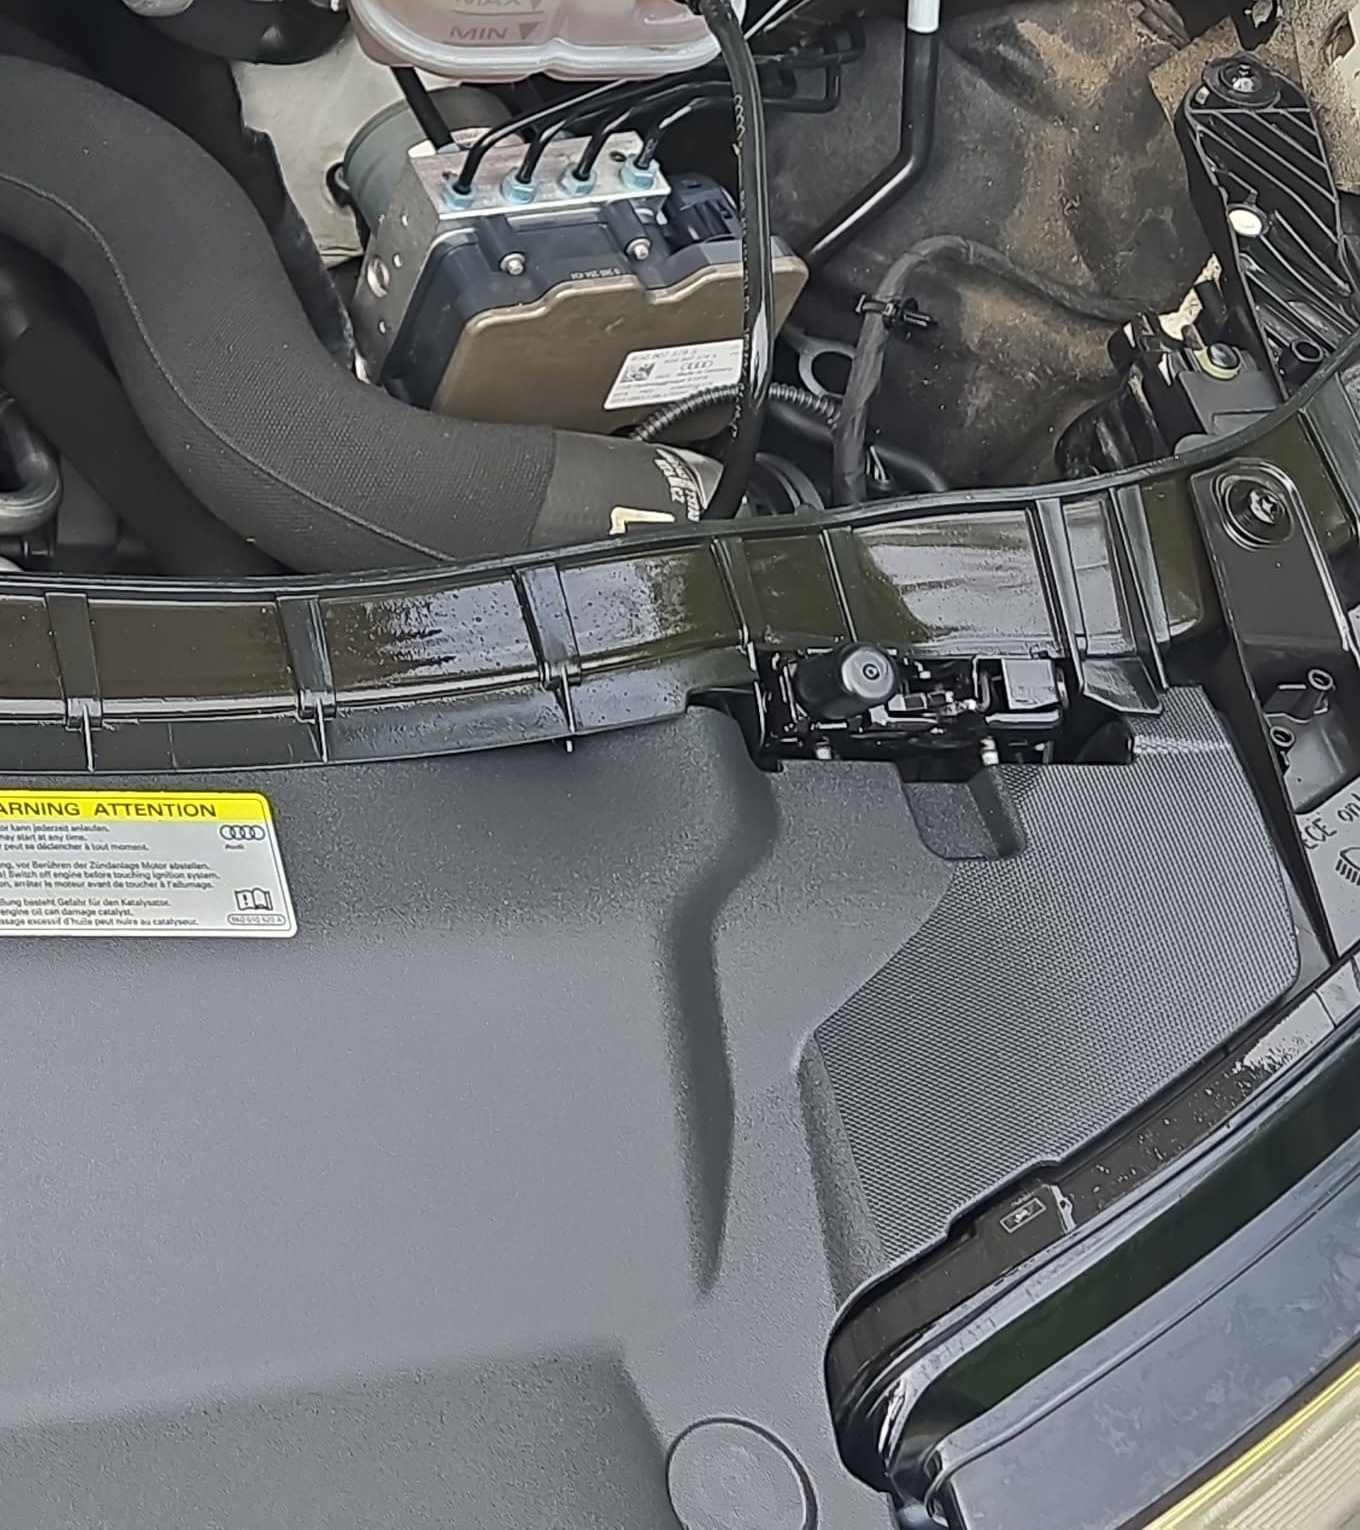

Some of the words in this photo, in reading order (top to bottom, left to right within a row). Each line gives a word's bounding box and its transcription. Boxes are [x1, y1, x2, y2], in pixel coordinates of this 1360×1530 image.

[449, 25, 509, 40] MIN
[94, 802, 217, 818] ATTENTION
[10, 823, 31, 831] kann
[48, 833, 64, 842] any
[4, 842, 23, 850] peut
[91, 842, 109, 850] tout
[73, 861, 87, 869] der
[141, 861, 167, 869] Motor
[53, 870, 81, 879] engine
[84, 870, 112, 878] before
[113, 870, 151, 879] touching
[153, 870, 185, 879] ignition
[54, 880, 85, 888] moteur
[87, 880, 111, 888] avant
[113, 880, 124, 888] de
[125, 880, 158, 888] toucher
[57, 897, 86, 906] Gefahr
[88, 897, 101, 906] für
[103, 897, 119, 906] den
[0, 908, 29, 916] engine
[61, 908, 96, 916] damage
[95, 917, 114, 925] peut
[116, 917, 138, 925] nuire
[140, 917, 151, 925] au
